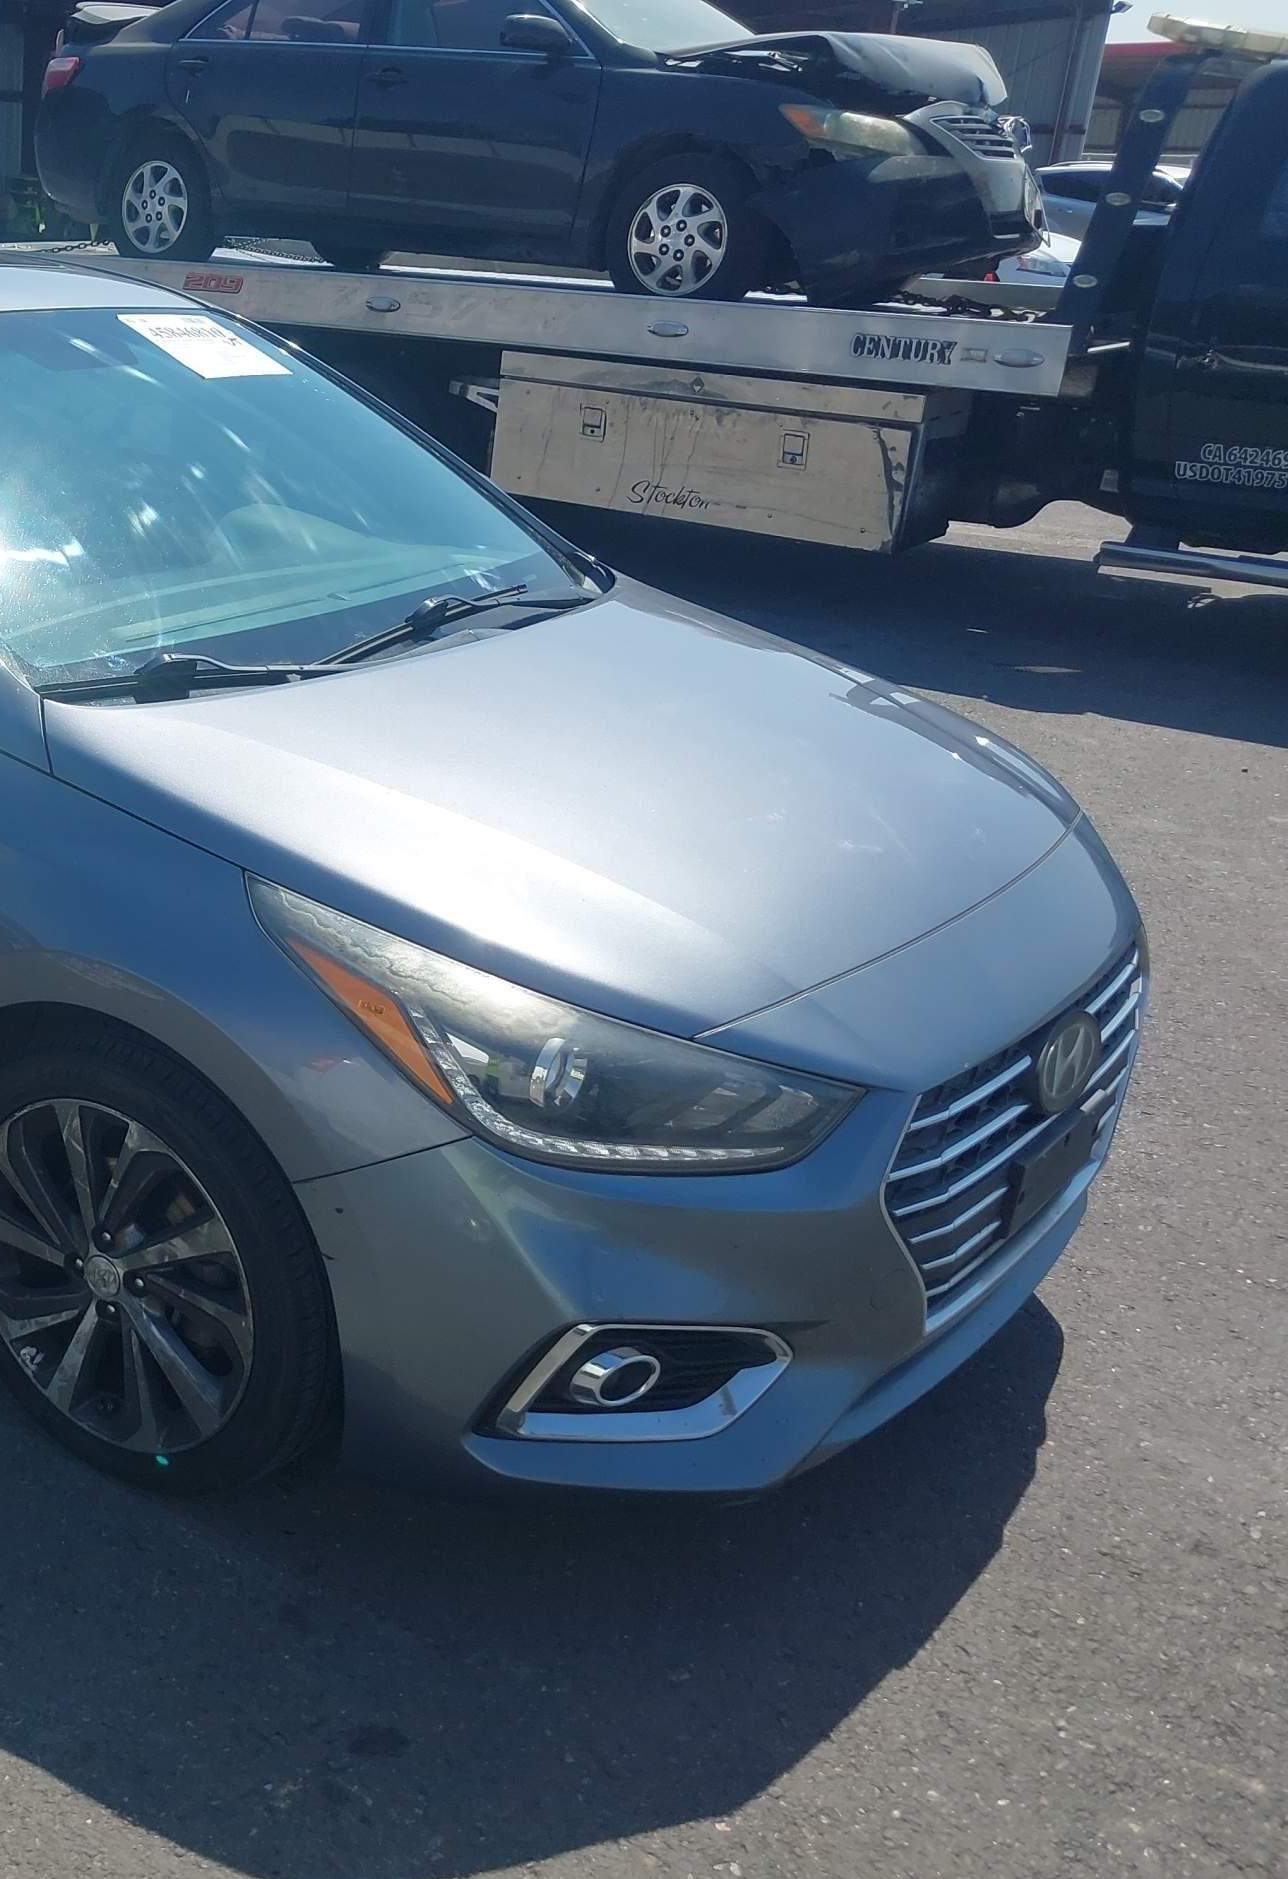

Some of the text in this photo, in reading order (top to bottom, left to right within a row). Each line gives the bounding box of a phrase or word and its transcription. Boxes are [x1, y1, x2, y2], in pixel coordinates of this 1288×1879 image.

[183, 272, 243, 294] 209
[850, 332, 958, 366] CENTURY
[1200, 443, 1224, 463] CA
[1175, 461, 1288, 489] USDOT41975
[626, 480, 710, 509] Stockton
